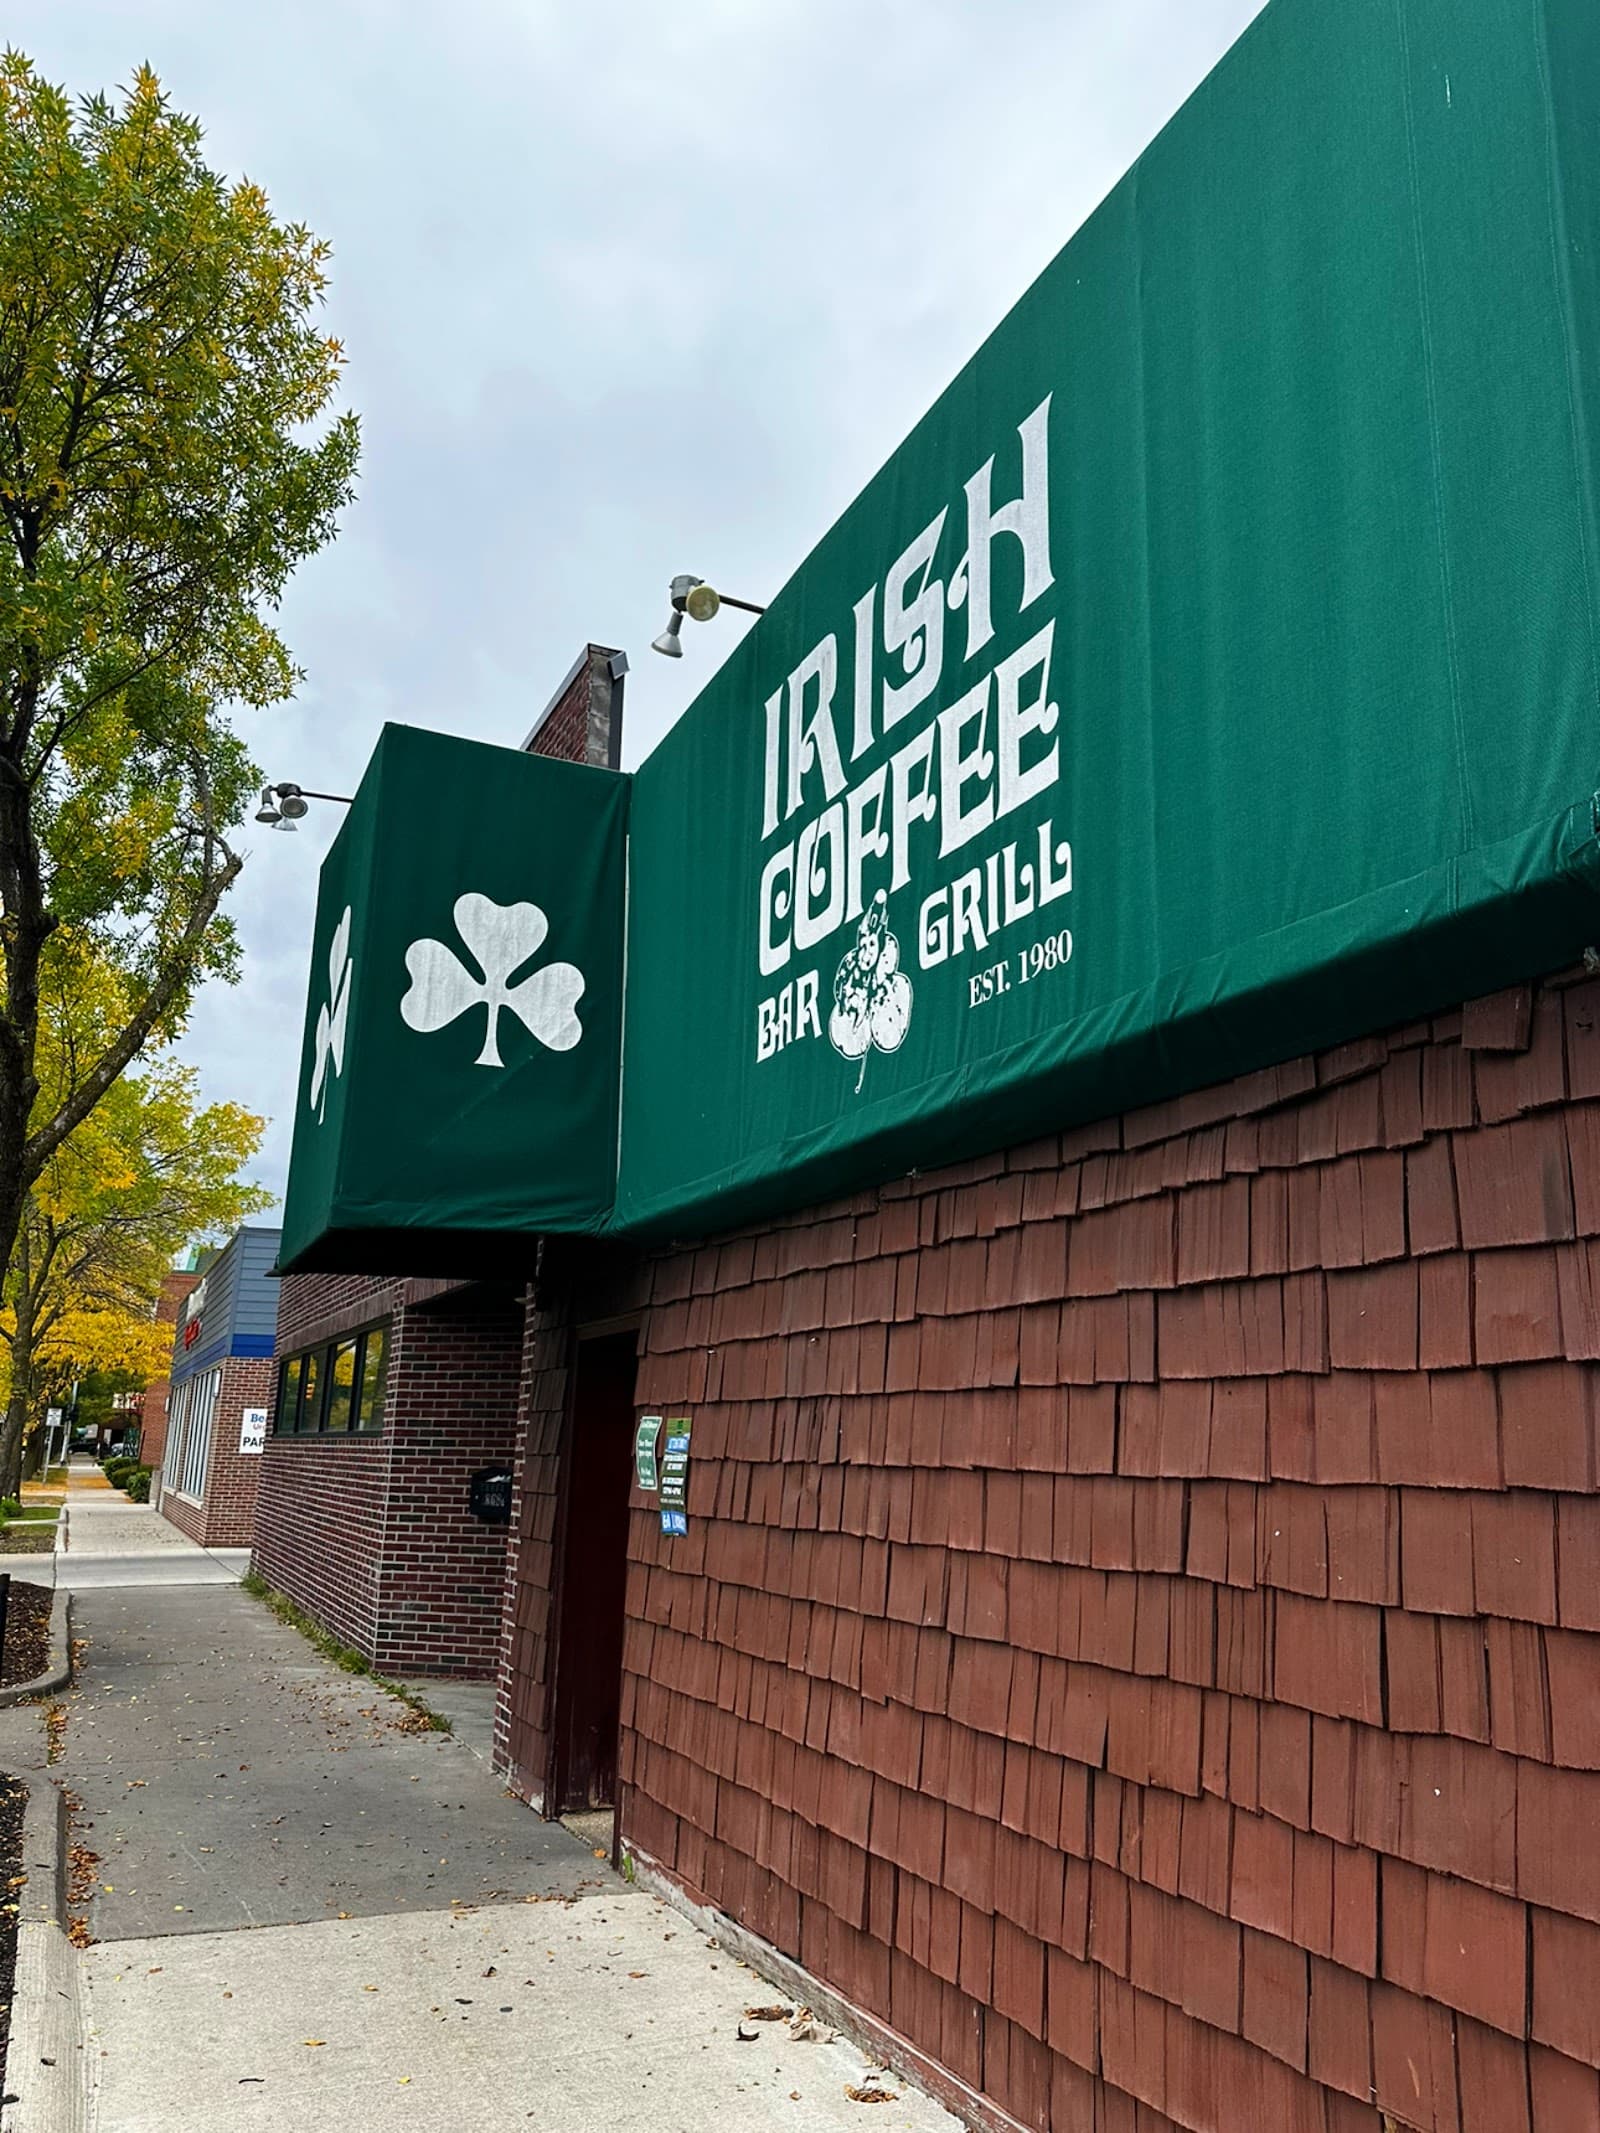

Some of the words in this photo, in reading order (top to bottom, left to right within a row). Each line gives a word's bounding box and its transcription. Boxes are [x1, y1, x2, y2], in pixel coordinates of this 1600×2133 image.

[761, 391, 1055, 842] IRISH
[759, 617, 1060, 977] COFFEE
[919, 818, 1073, 970] GRILL
[969, 961, 1011, 1008] EST.
[1018, 929, 1073, 984] 1980
[756, 969, 823, 1063] BAR
